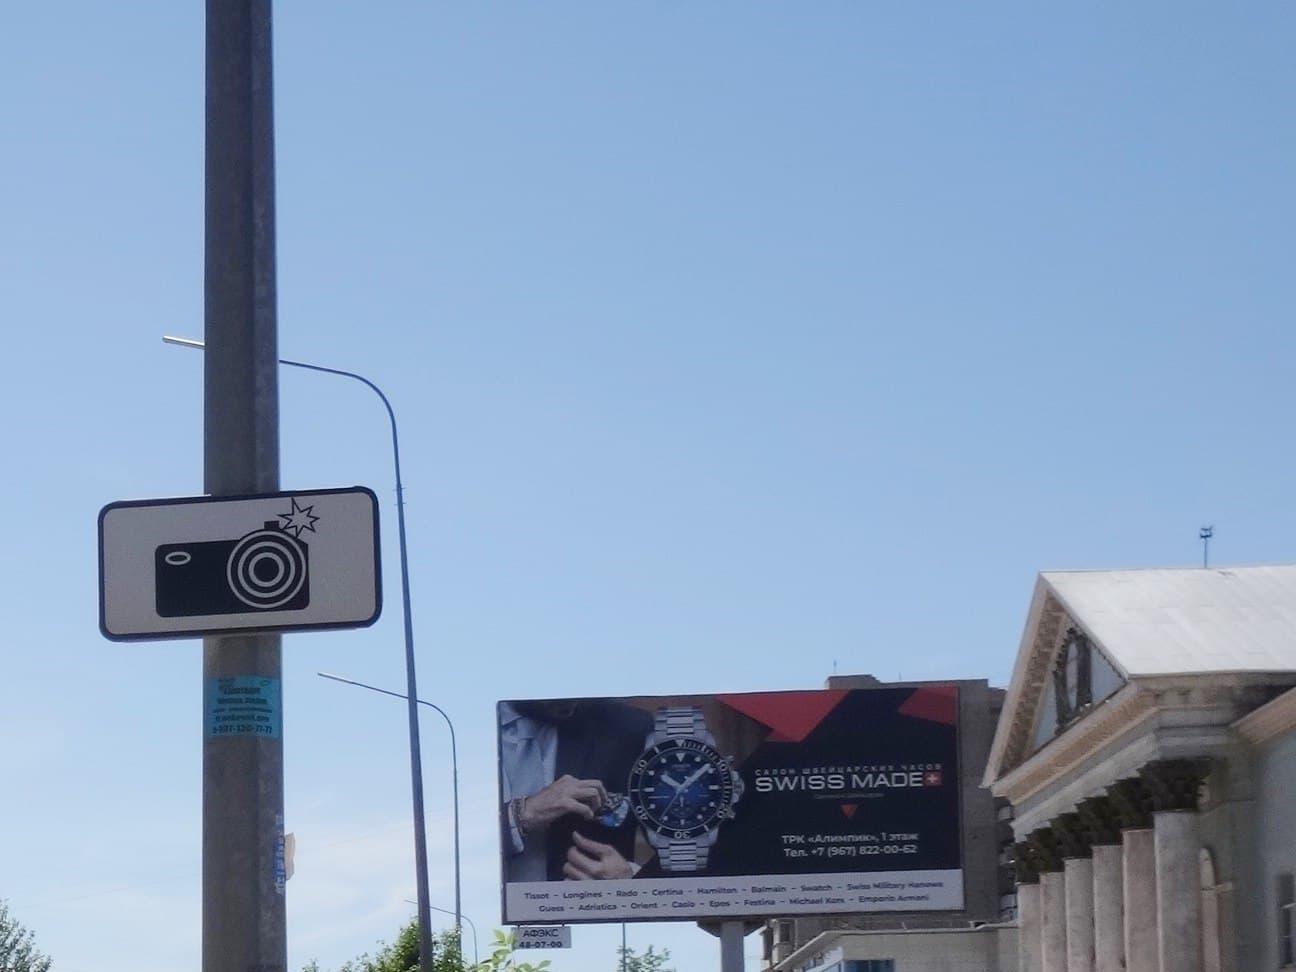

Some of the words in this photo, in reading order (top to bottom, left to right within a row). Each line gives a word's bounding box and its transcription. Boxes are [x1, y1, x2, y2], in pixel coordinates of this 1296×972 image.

[755, 768, 796, 776] САЛОН
[755, 774, 845, 792] SWISS
[852, 772, 923, 789] MADE
[782, 834, 805, 844] ТРК
[889, 833, 918, 842] этаж
[784, 848, 808, 857] Тел.
[811, 847, 825, 856] +7
[524, 892, 549, 900] Tissot
[563, 891, 602, 900] Longines
[616, 889, 638, 897] Rado
[652, 888, 683, 896] Certina
[539, 904, 565, 912] Guess
[578, 902, 617, 911] Adriatica
[630, 901, 658, 910] Orient
[672, 900, 695, 909] Casio
[709, 900, 730, 908] Epos
[744, 898, 776, 906] Festina
[522, 928, 560, 938] АФЭКС
